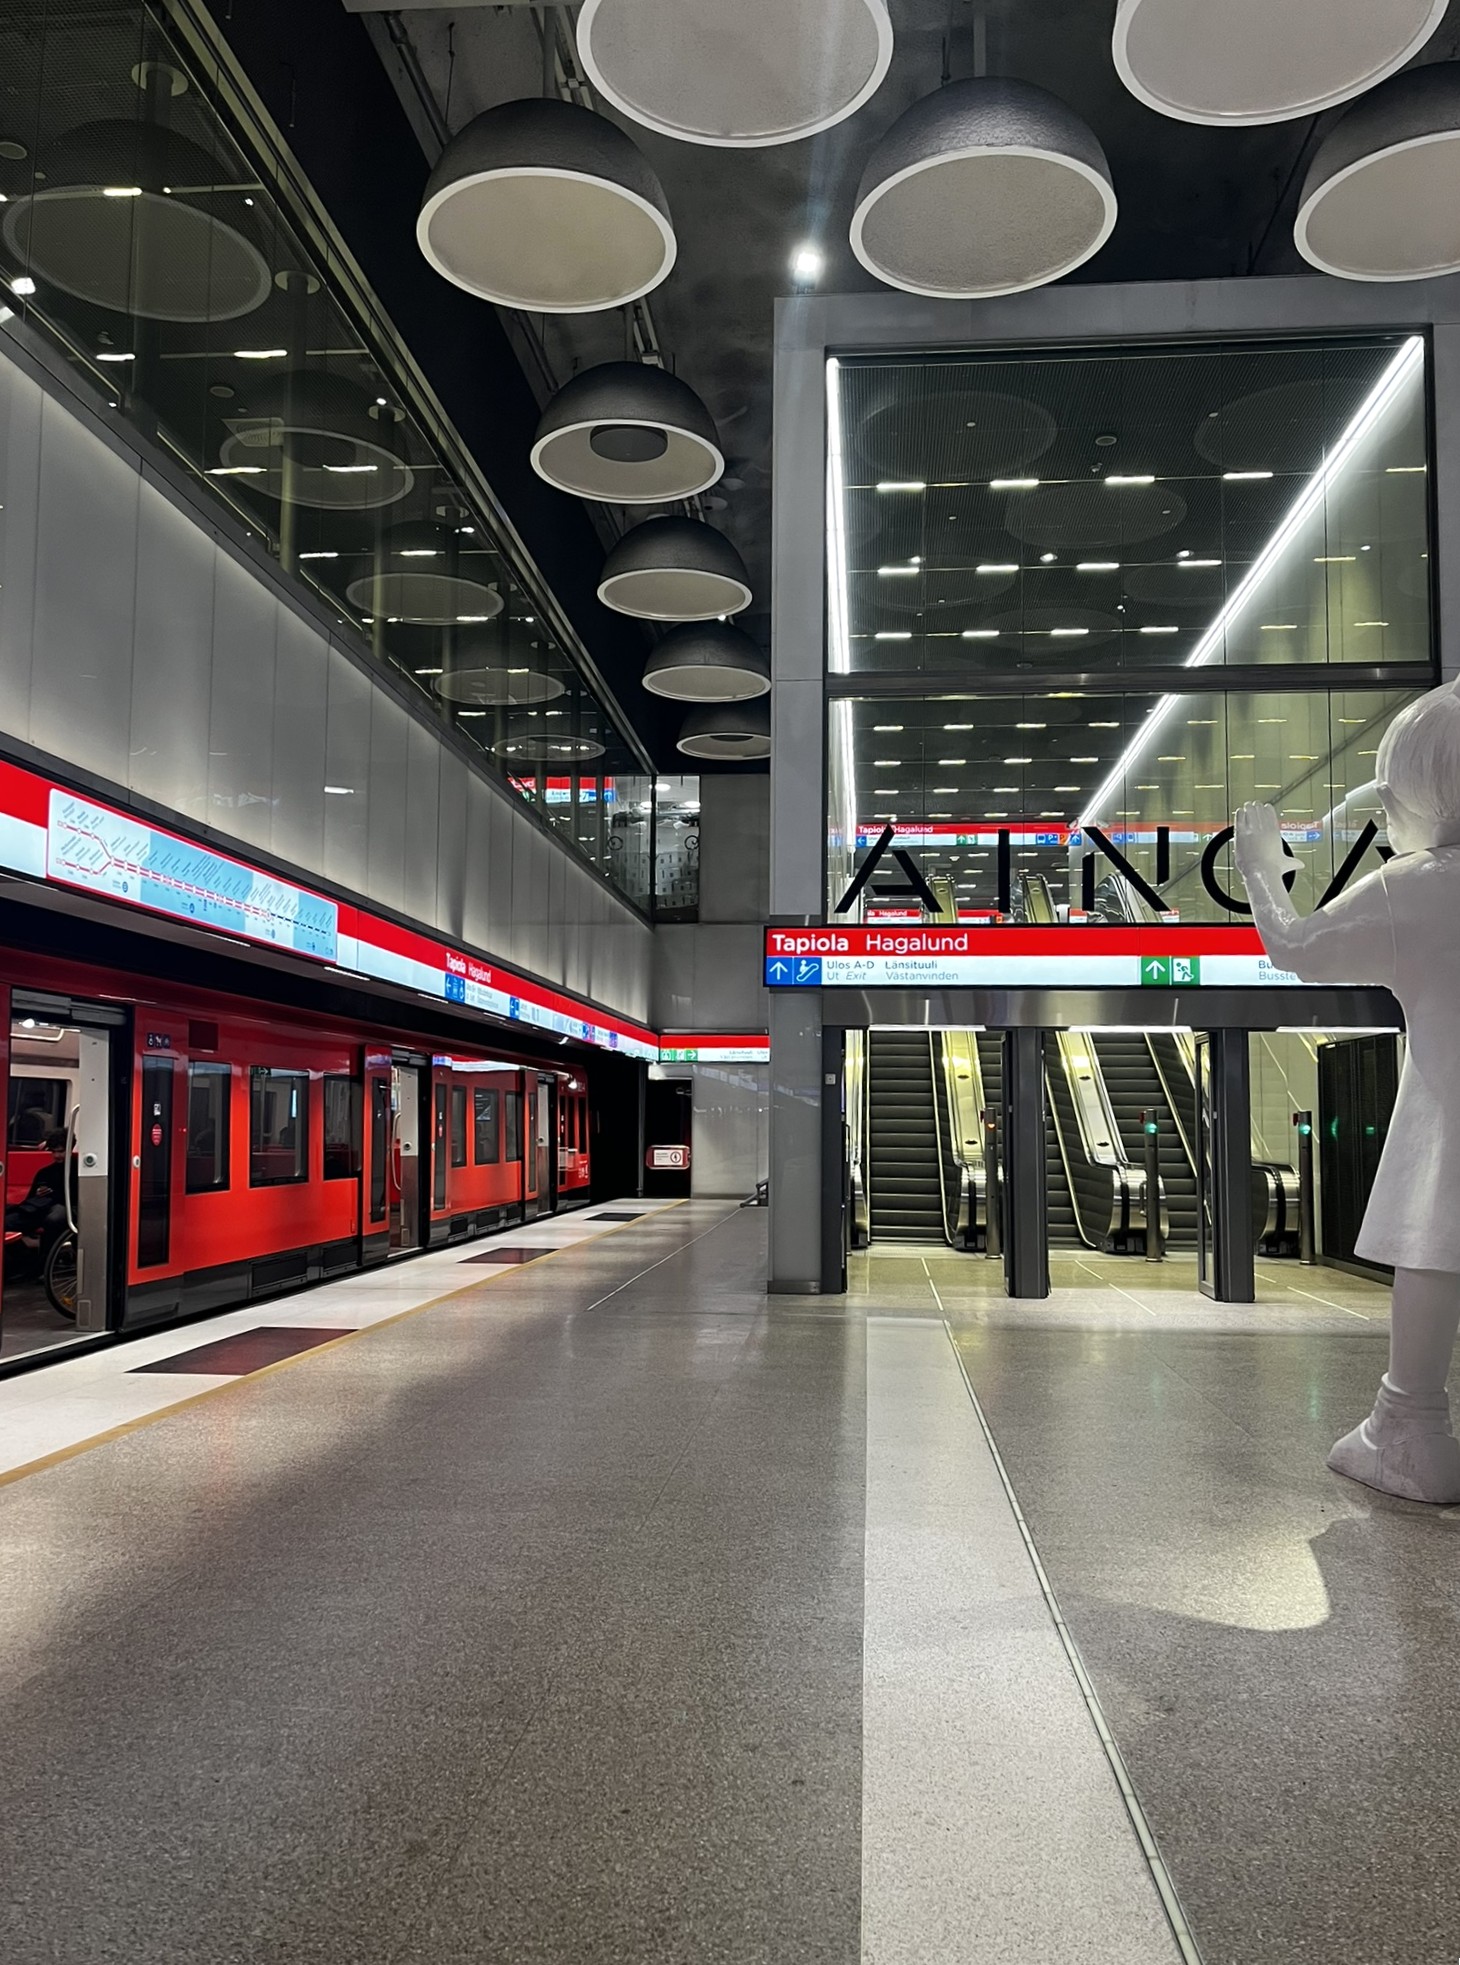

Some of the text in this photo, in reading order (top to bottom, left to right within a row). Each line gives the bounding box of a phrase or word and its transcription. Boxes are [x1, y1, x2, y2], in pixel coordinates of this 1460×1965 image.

[858, 825, 886, 835] Tapiol
[772, 932, 968, 954] Tapiola Hagalund
[445, 952, 492, 984] Tapiola Hagalund
[826, 960, 938, 970] Ulos A-D Länsituuli
[826, 971, 959, 981] Ut Exit Västanvinden
[1258, 971, 1297, 981] Busste
